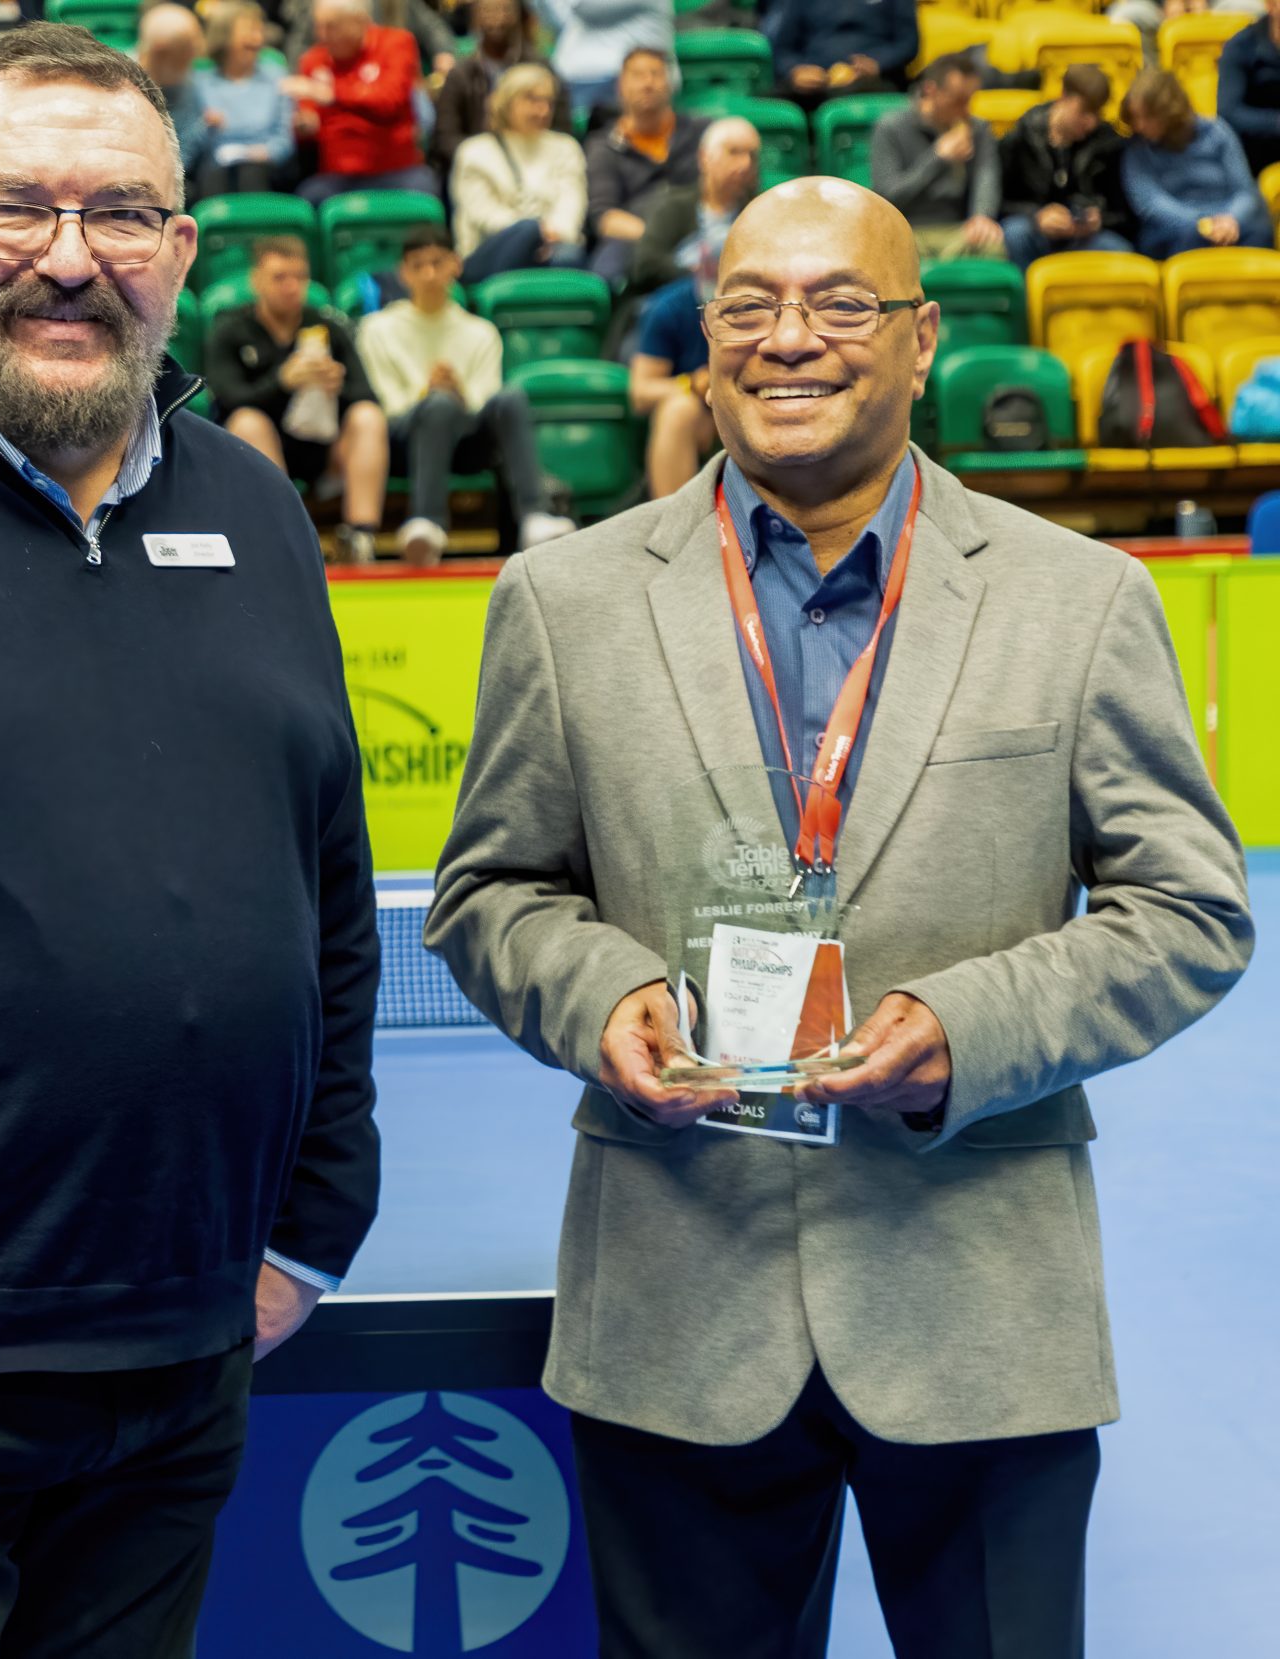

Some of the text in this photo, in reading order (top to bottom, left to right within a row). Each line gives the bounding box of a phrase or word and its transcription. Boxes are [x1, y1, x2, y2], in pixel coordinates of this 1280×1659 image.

[734, 841, 789, 863] Table
[725, 859, 791, 878] Tennis
[694, 900, 812, 917] LESLIE FORREST
